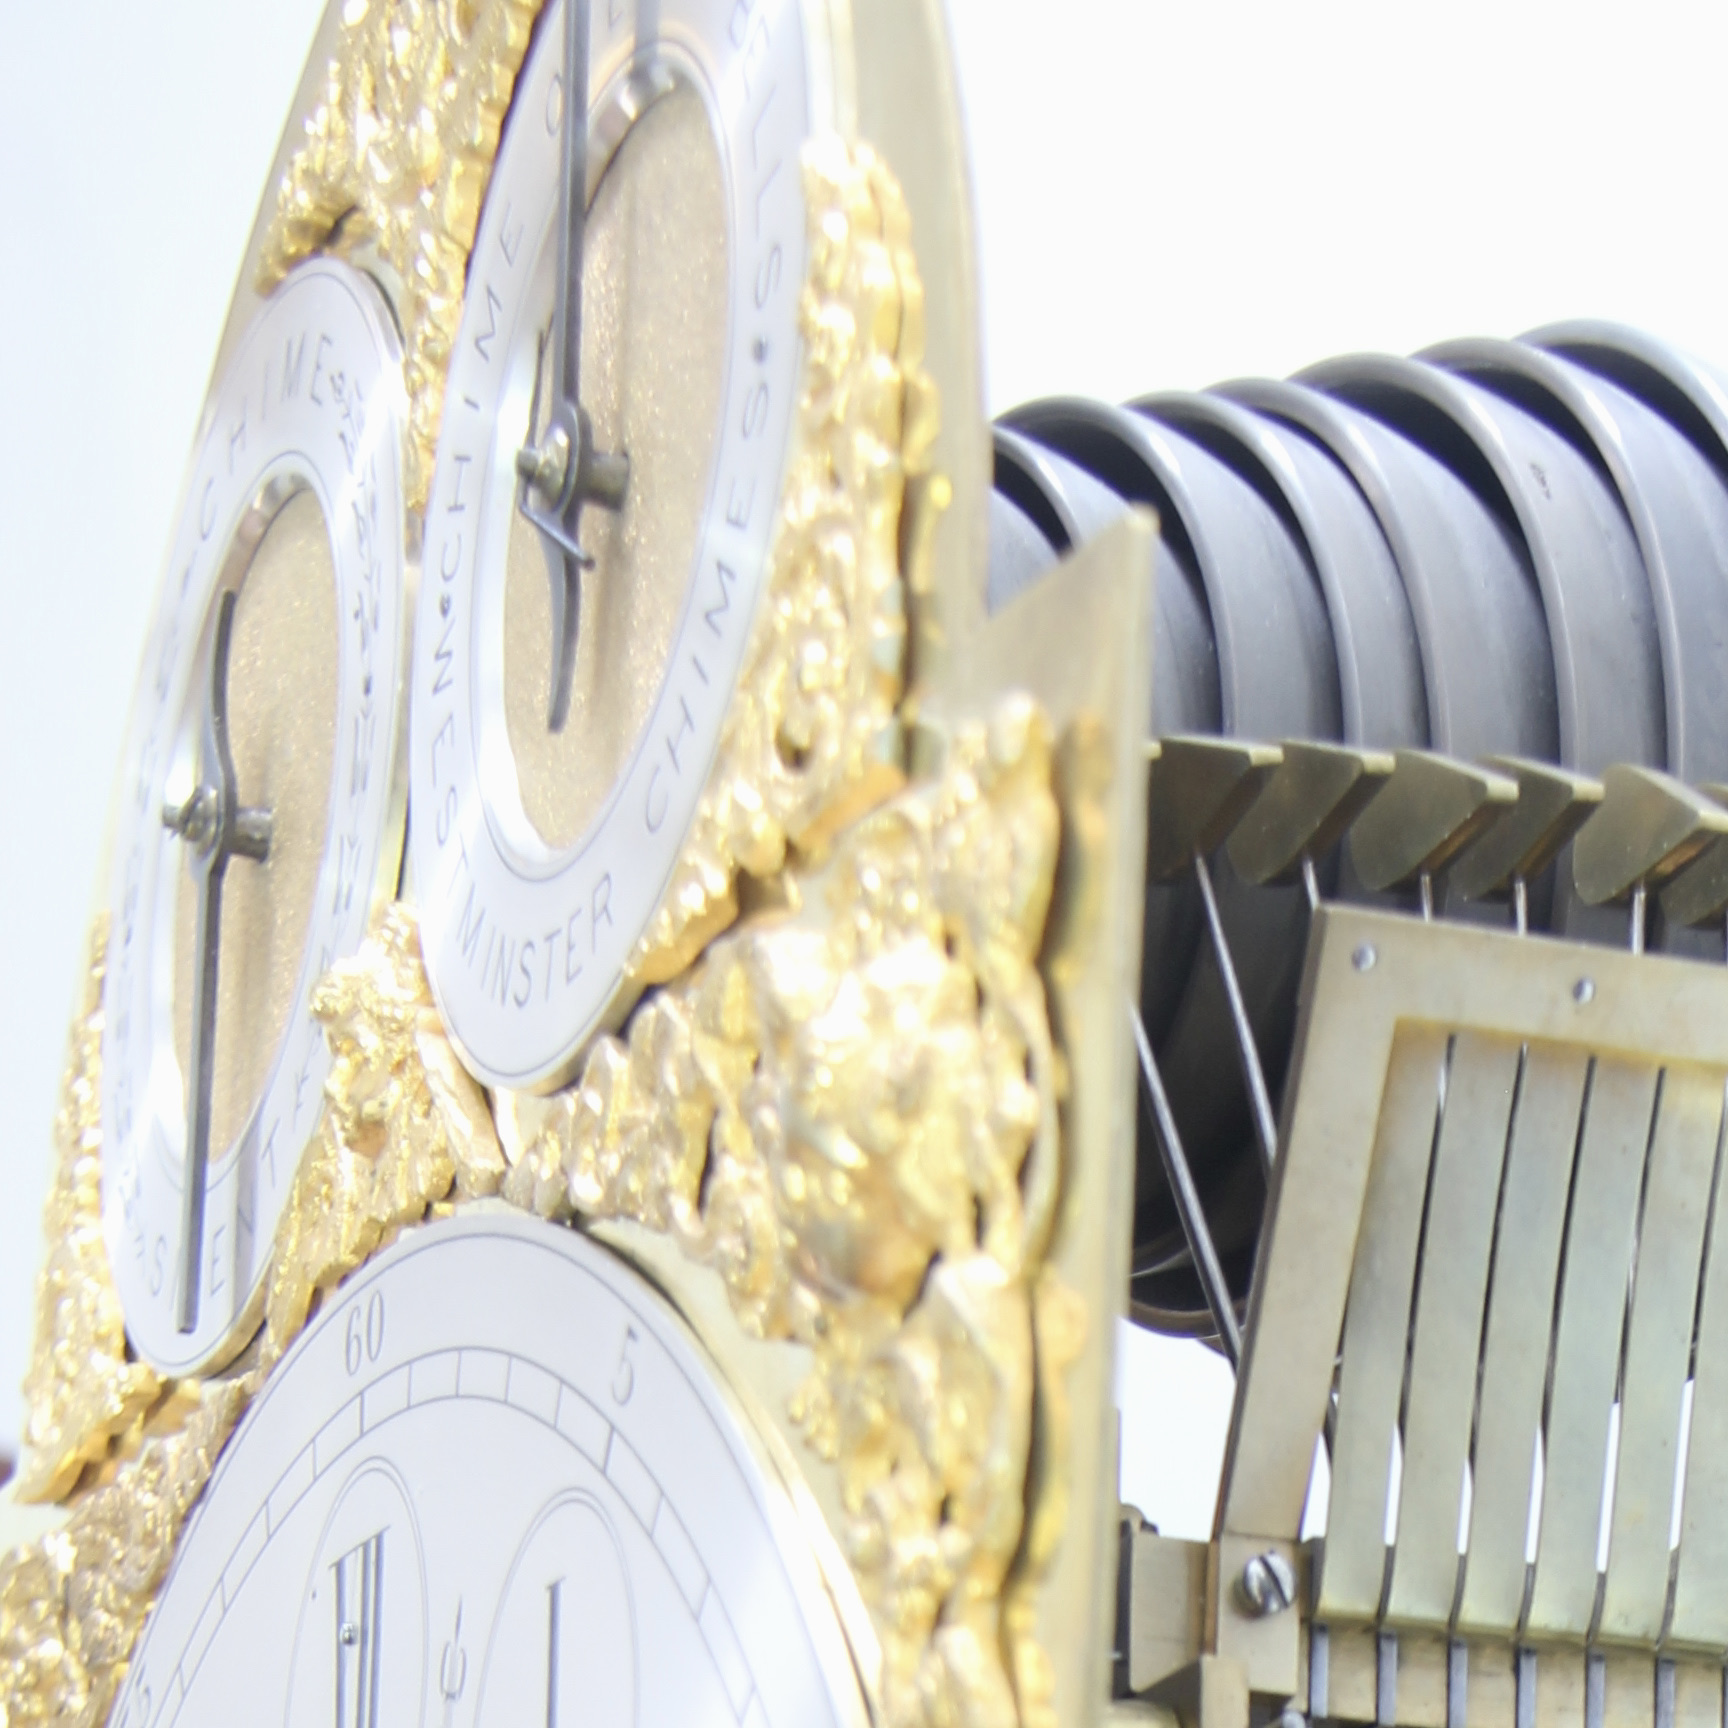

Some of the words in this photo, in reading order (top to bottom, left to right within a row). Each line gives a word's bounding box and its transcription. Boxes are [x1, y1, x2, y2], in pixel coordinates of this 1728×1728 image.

[200, 330, 334, 541] CHIME
[441, 202, 526, 582] CHIME
[431, 614, 614, 1010] WESTMINSTER
[645, 383, 770, 835] CHIMES
[150, 1115, 284, 1313] SIENT
[344, 1288, 386, 1377] 60
[611, 1323, 641, 1408] 5
